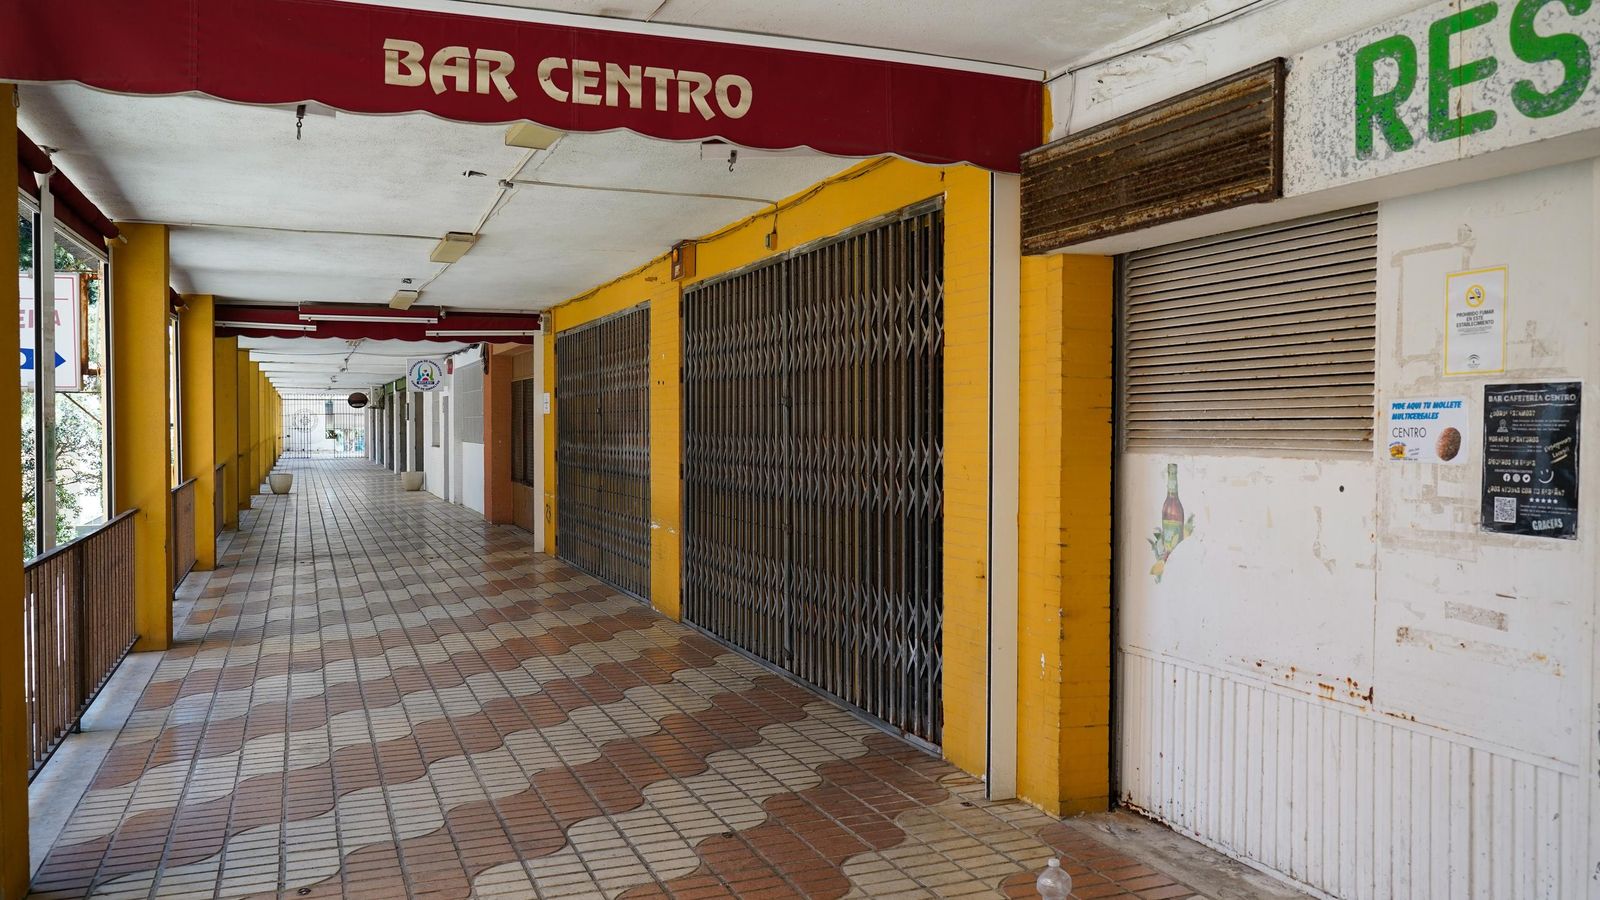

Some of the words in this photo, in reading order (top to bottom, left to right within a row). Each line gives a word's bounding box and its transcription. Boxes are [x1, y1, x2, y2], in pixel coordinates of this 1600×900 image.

[383, 38, 518, 103] BAR
[537, 57, 753, 121] CENTRO
[1355, 0, 1592, 160] RES
[1456, 320, 1495, 328] ESTABLECIMIENTO
[1544, 393, 1577, 401] CENTRO
[1423, 401, 1433, 409] TU
[1432, 400, 1462, 409] MOLLETE
[1392, 427, 1427, 438] CENTRO
[1532, 518, 1563, 531] GRACIAS
